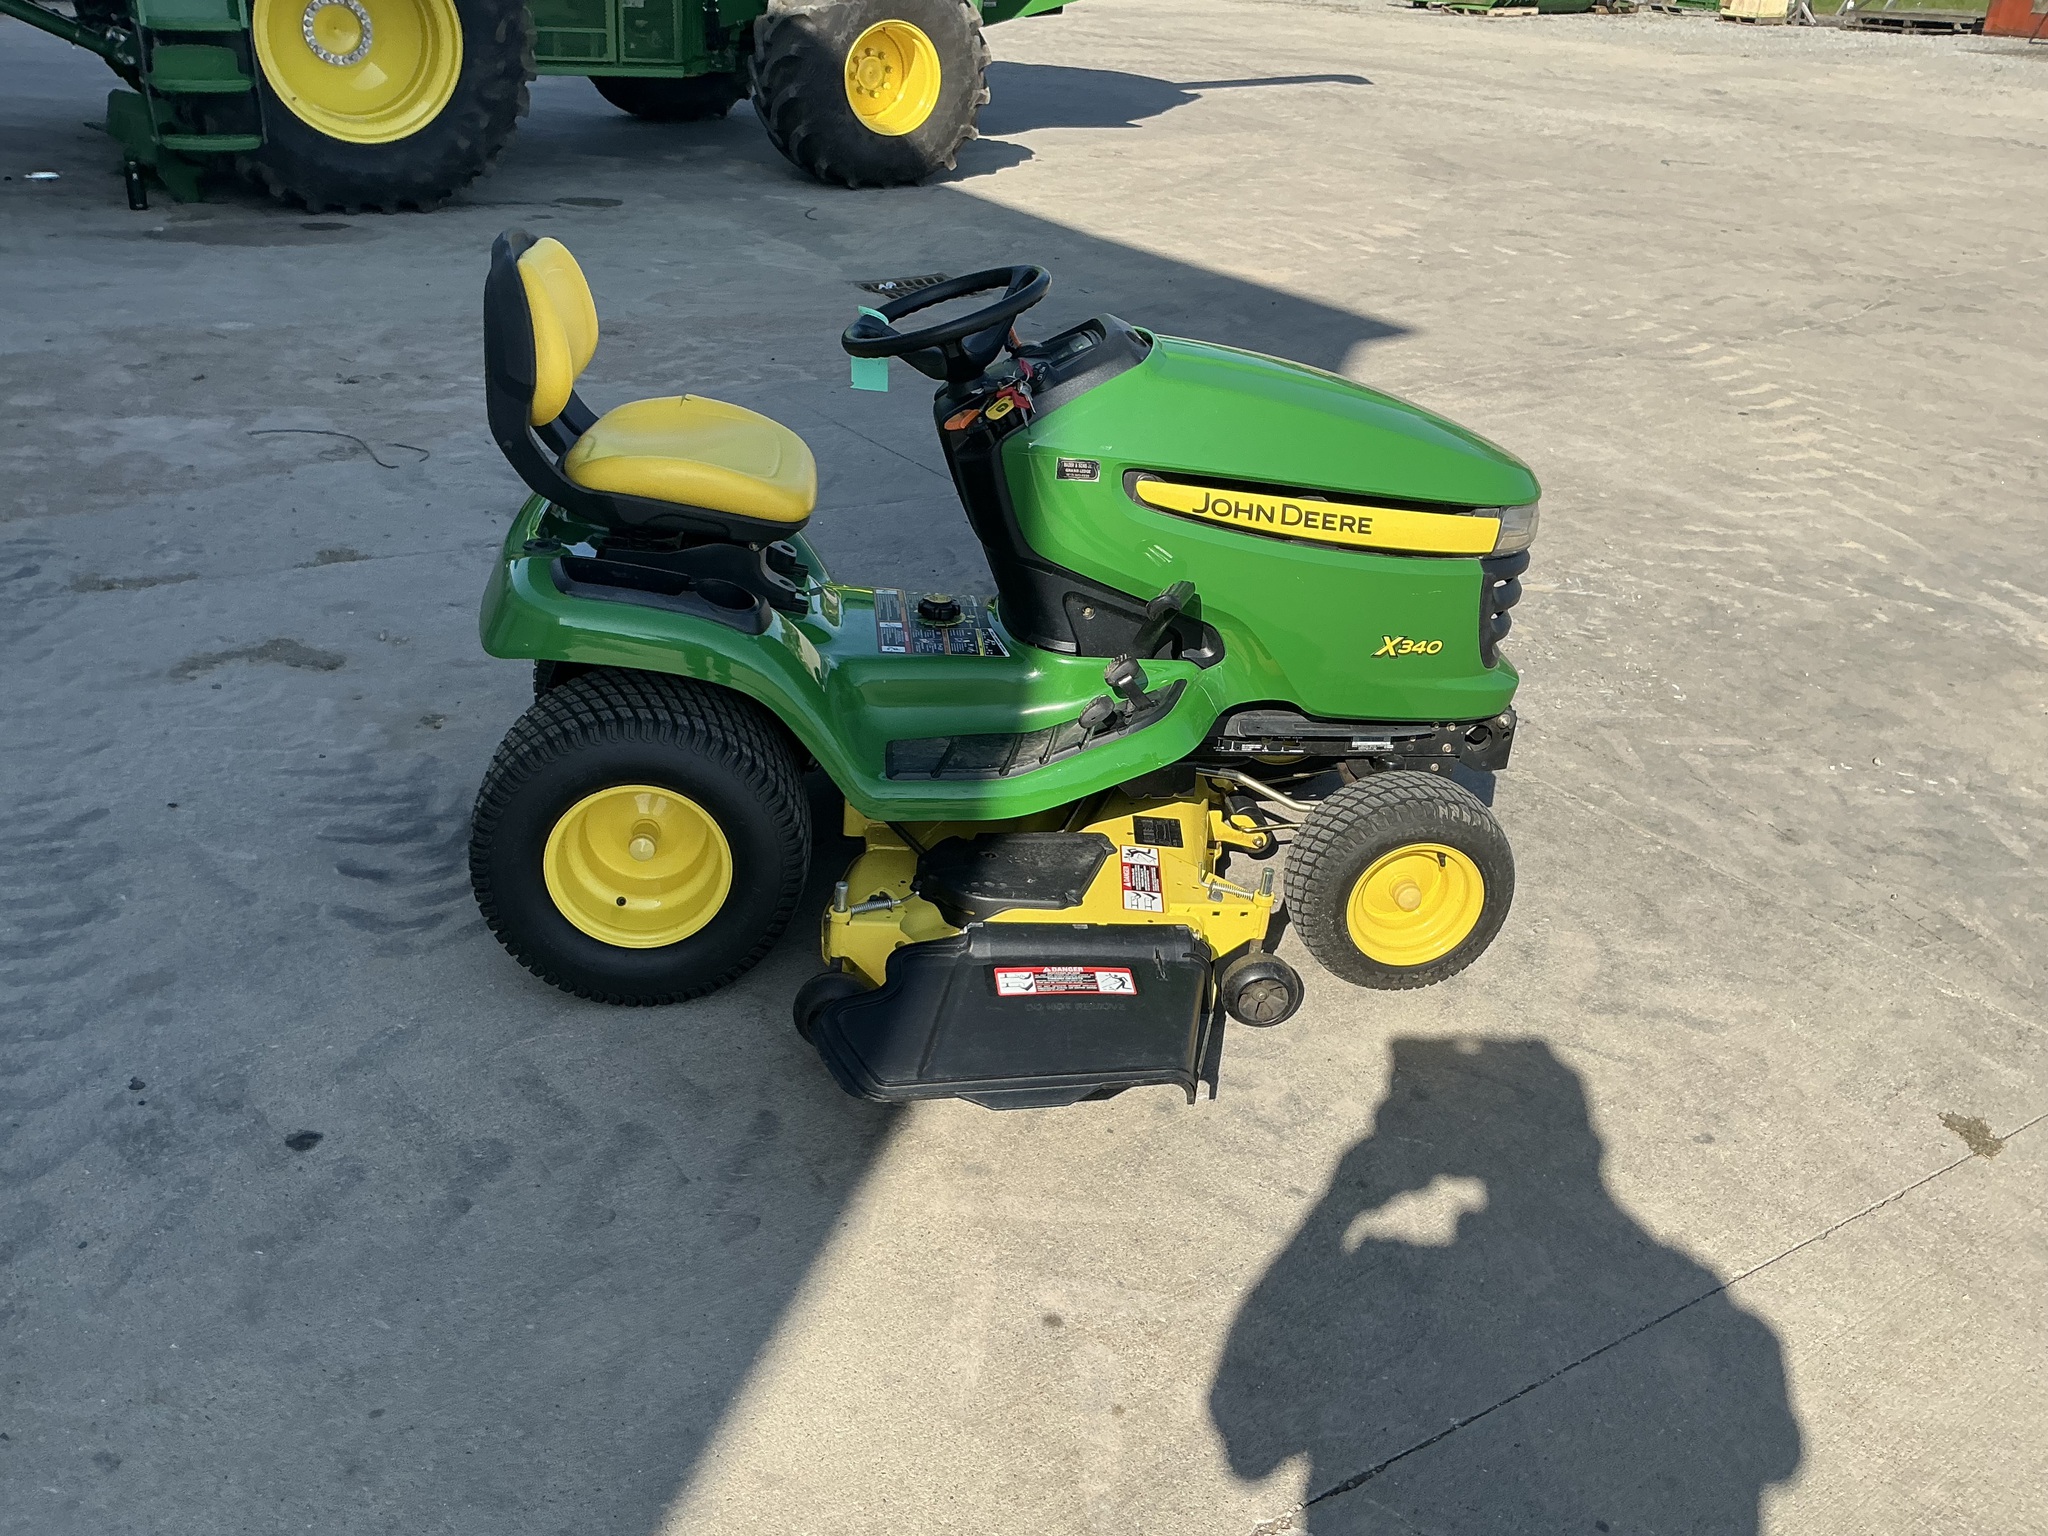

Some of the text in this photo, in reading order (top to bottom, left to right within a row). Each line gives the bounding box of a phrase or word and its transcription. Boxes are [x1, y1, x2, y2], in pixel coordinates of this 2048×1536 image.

[1192, 492, 1373, 535] JOHN DEERE
[1371, 634, 1444, 658] X340
